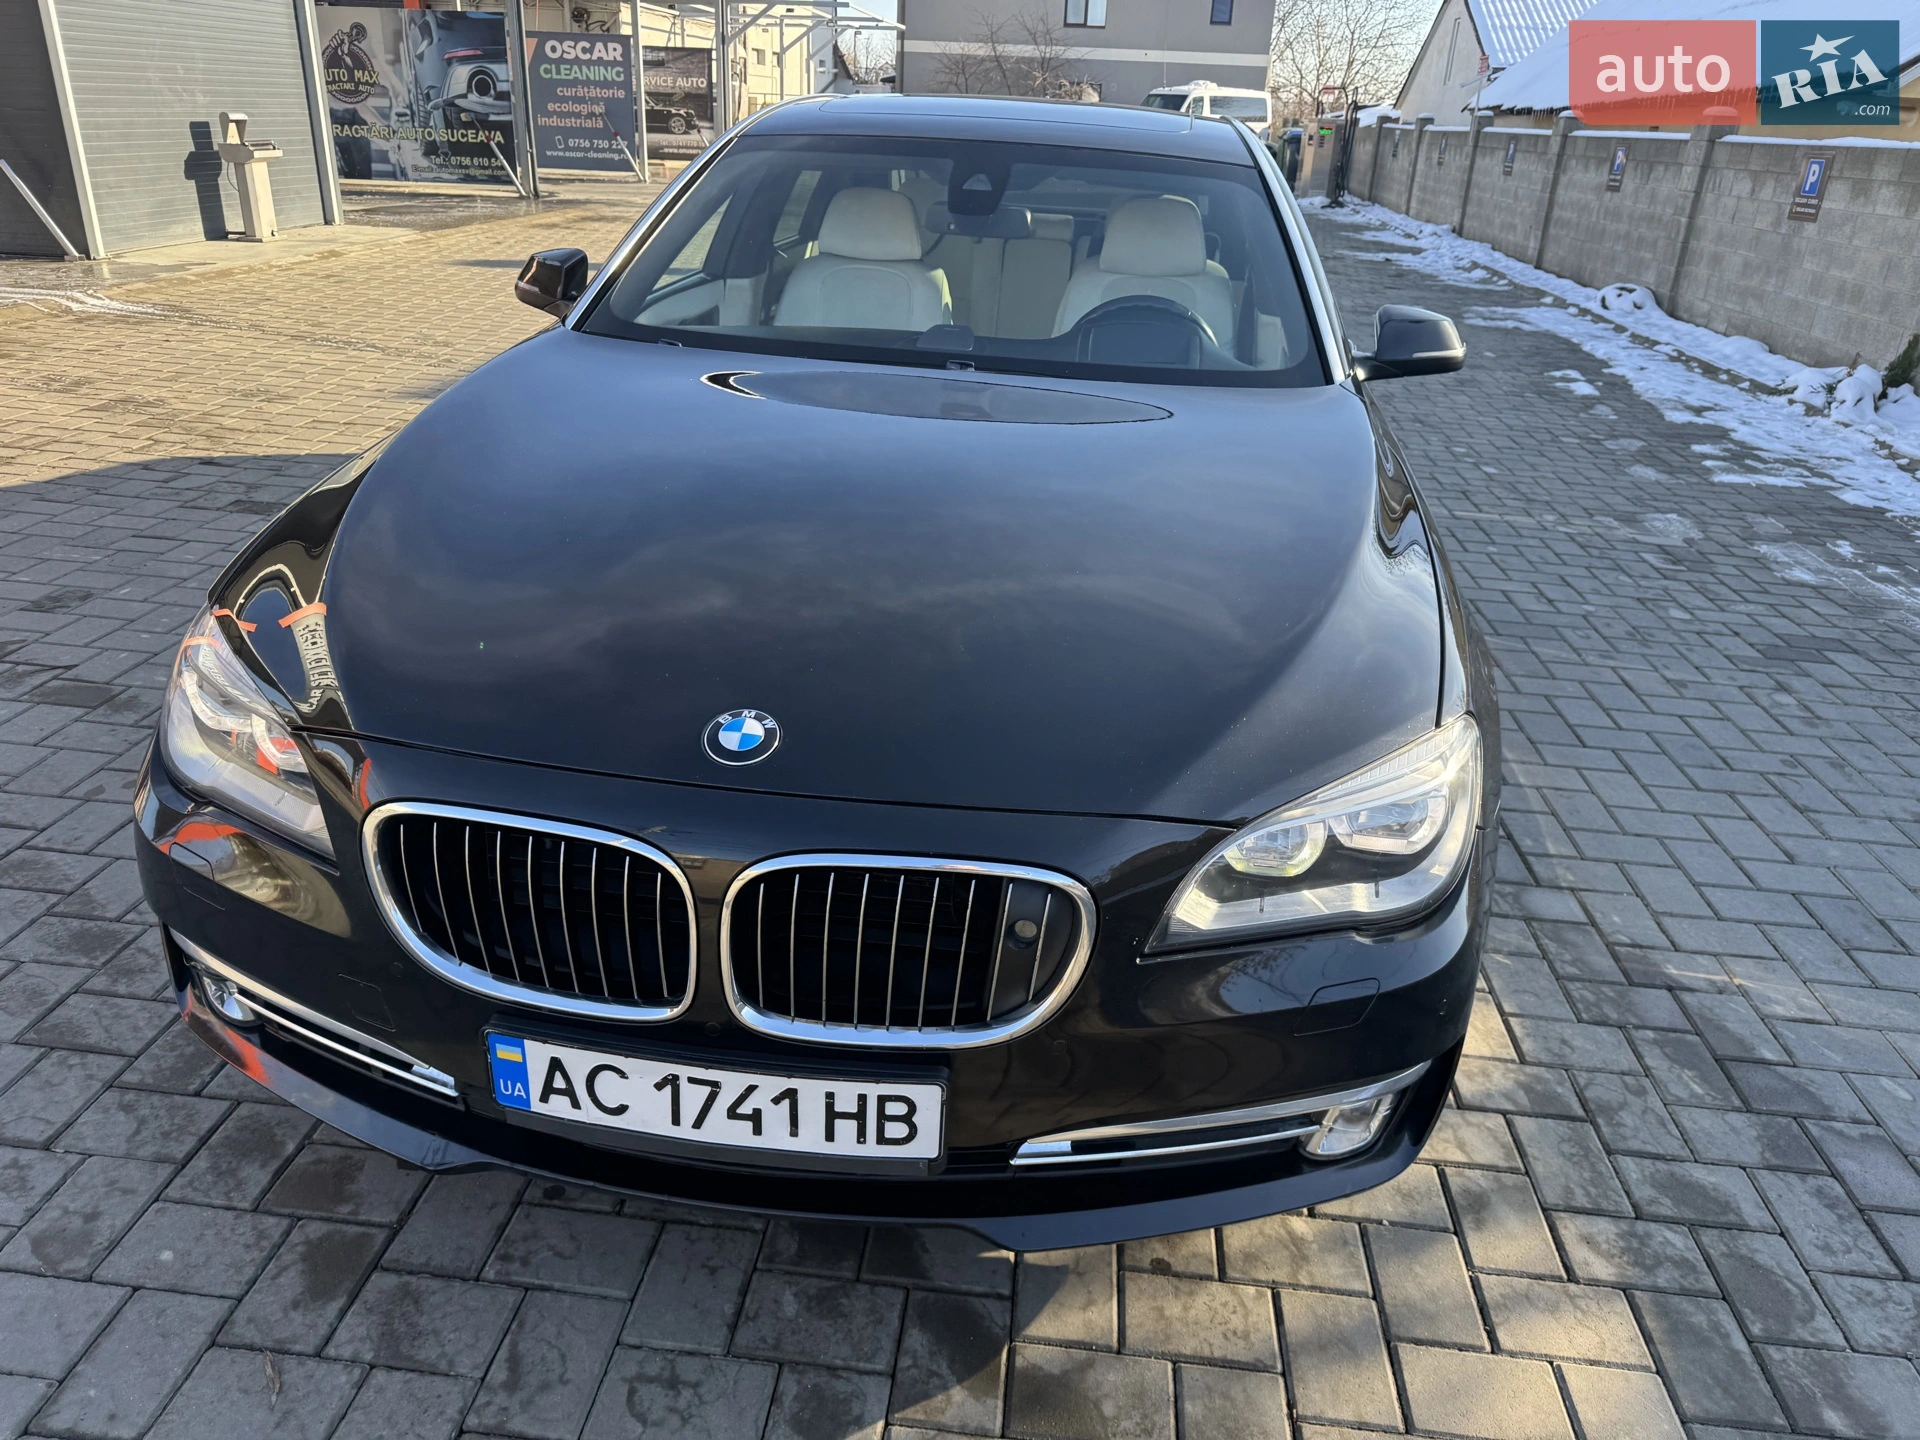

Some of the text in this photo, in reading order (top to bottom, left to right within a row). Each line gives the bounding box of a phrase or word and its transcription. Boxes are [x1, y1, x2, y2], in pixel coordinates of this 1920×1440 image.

[544, 39, 623, 61] OSCAR
[325, 69, 379, 84] UTO MAX
[539, 63, 625, 82] CLEANING
[327, 83, 375, 95] RACTARI AUTO
[675, 77, 707, 87] AUTO
[556, 85, 625, 100] curățătorie
[537, 114, 604, 128] industrială
[332, 122, 505, 144] RACTĂRI AUTO SUCEAVA
[568, 139, 590, 148] 0756
[593, 139, 609, 149] 750
[430, 155, 449, 165] Tel.:
[451, 156, 471, 166] 0756
[473, 157, 489, 167] 610
[1805, 164, 1820, 191] P
[718, 710, 776, 729] BMW
[500, 1079, 526, 1100] UA
[538, 1055, 918, 1146] AC 1741 HB
